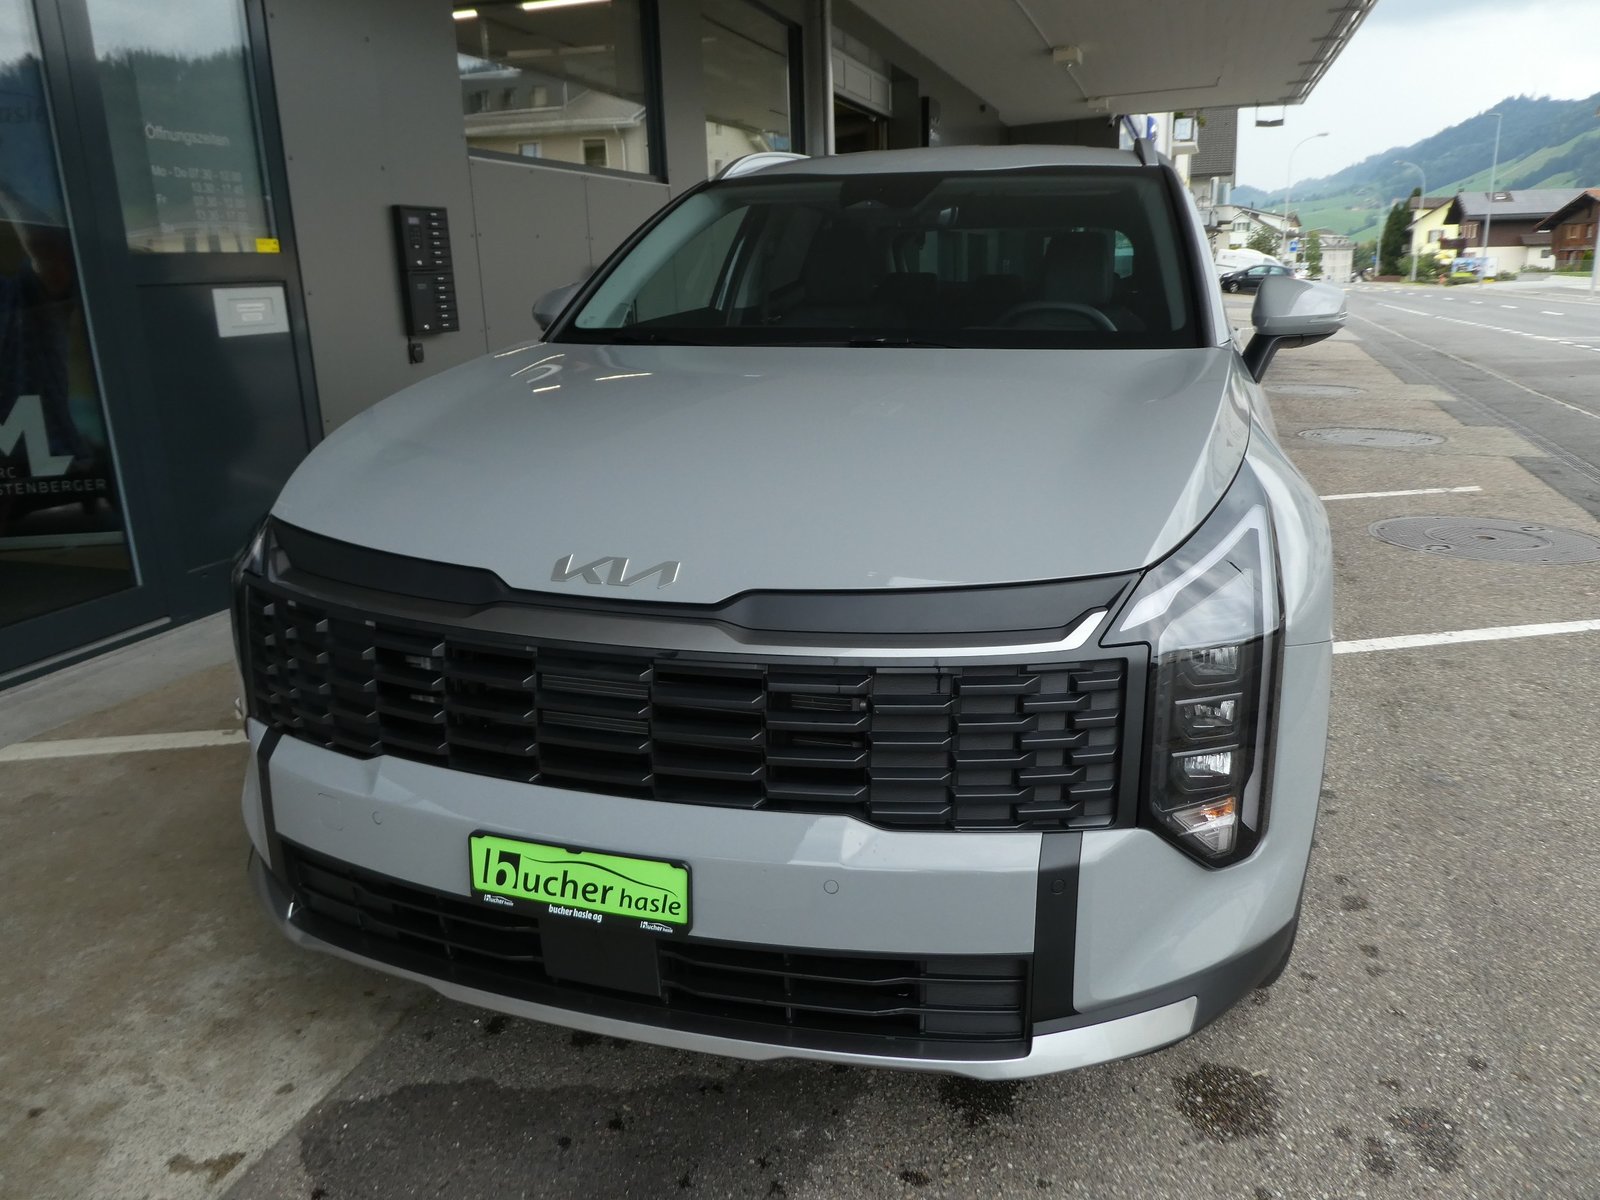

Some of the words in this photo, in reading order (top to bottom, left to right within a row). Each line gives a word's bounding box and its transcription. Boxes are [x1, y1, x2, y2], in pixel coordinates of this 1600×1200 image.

[551, 553, 681, 590] KIA
[483, 847, 614, 905] bucher
[619, 888, 682, 916] hasle
[548, 904, 573, 917] bucher
[573, 908, 593, 920] hasle
[592, 913, 603, 923] ag
